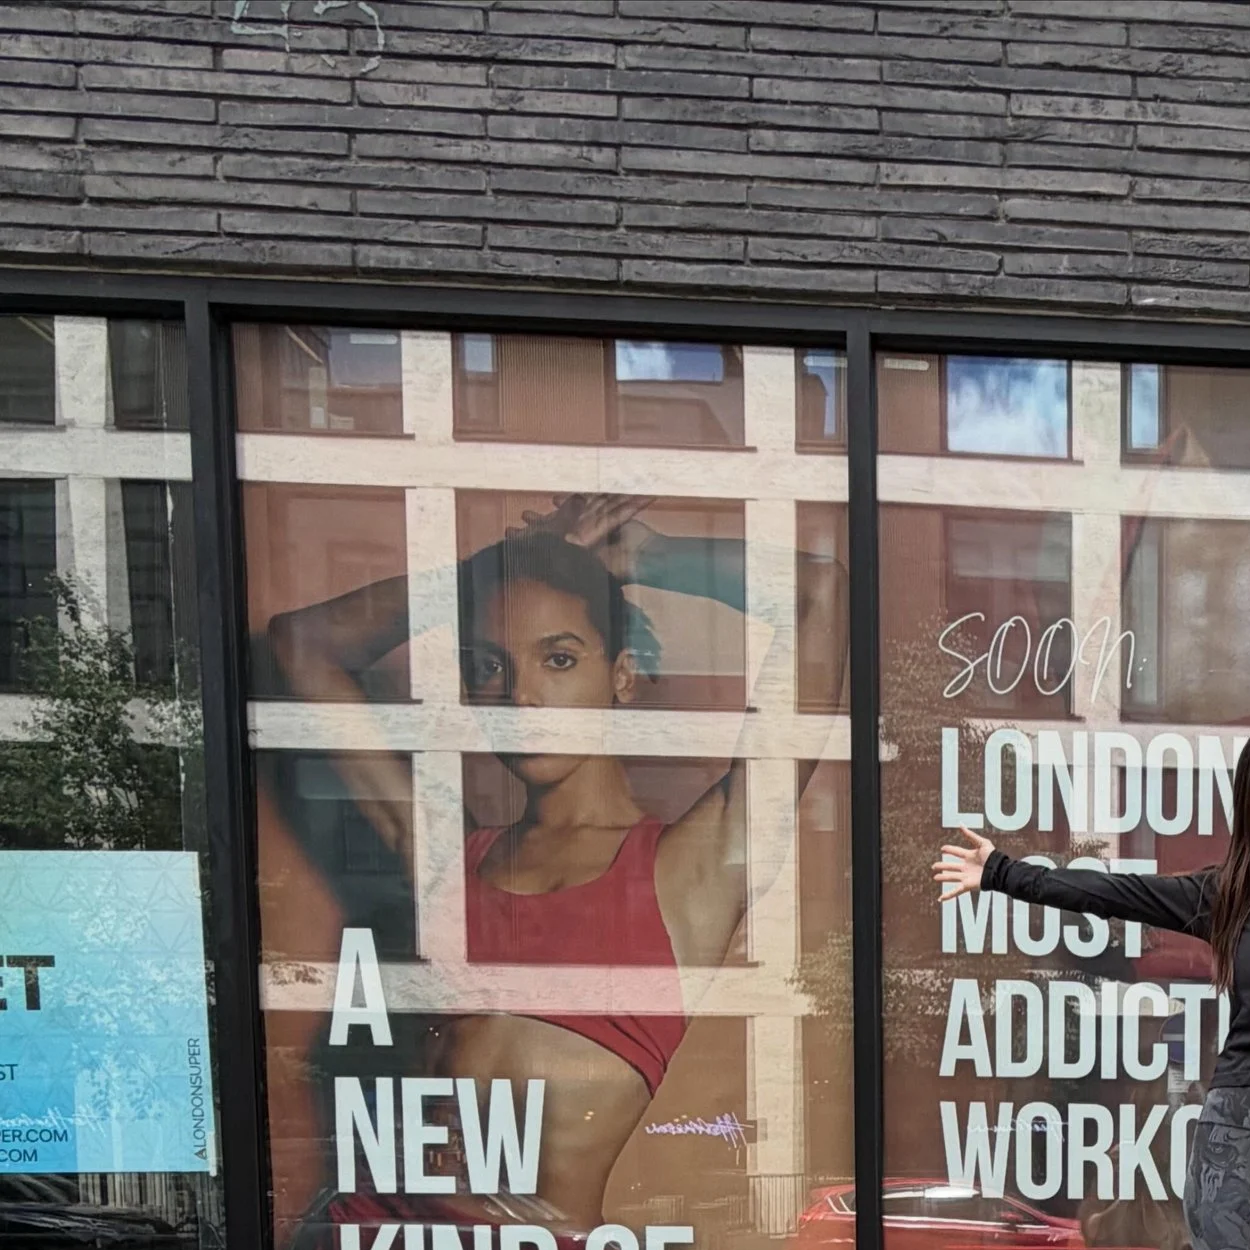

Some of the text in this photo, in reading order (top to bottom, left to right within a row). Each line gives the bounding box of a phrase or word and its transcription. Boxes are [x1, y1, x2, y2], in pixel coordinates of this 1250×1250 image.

[941, 727, 1249, 836] LONDON
[0, 955, 55, 1011] T
[328, 927, 394, 1046] A
[0, 1128, 68, 1143] ER.COM
[334, 1077, 546, 1194] NEW
